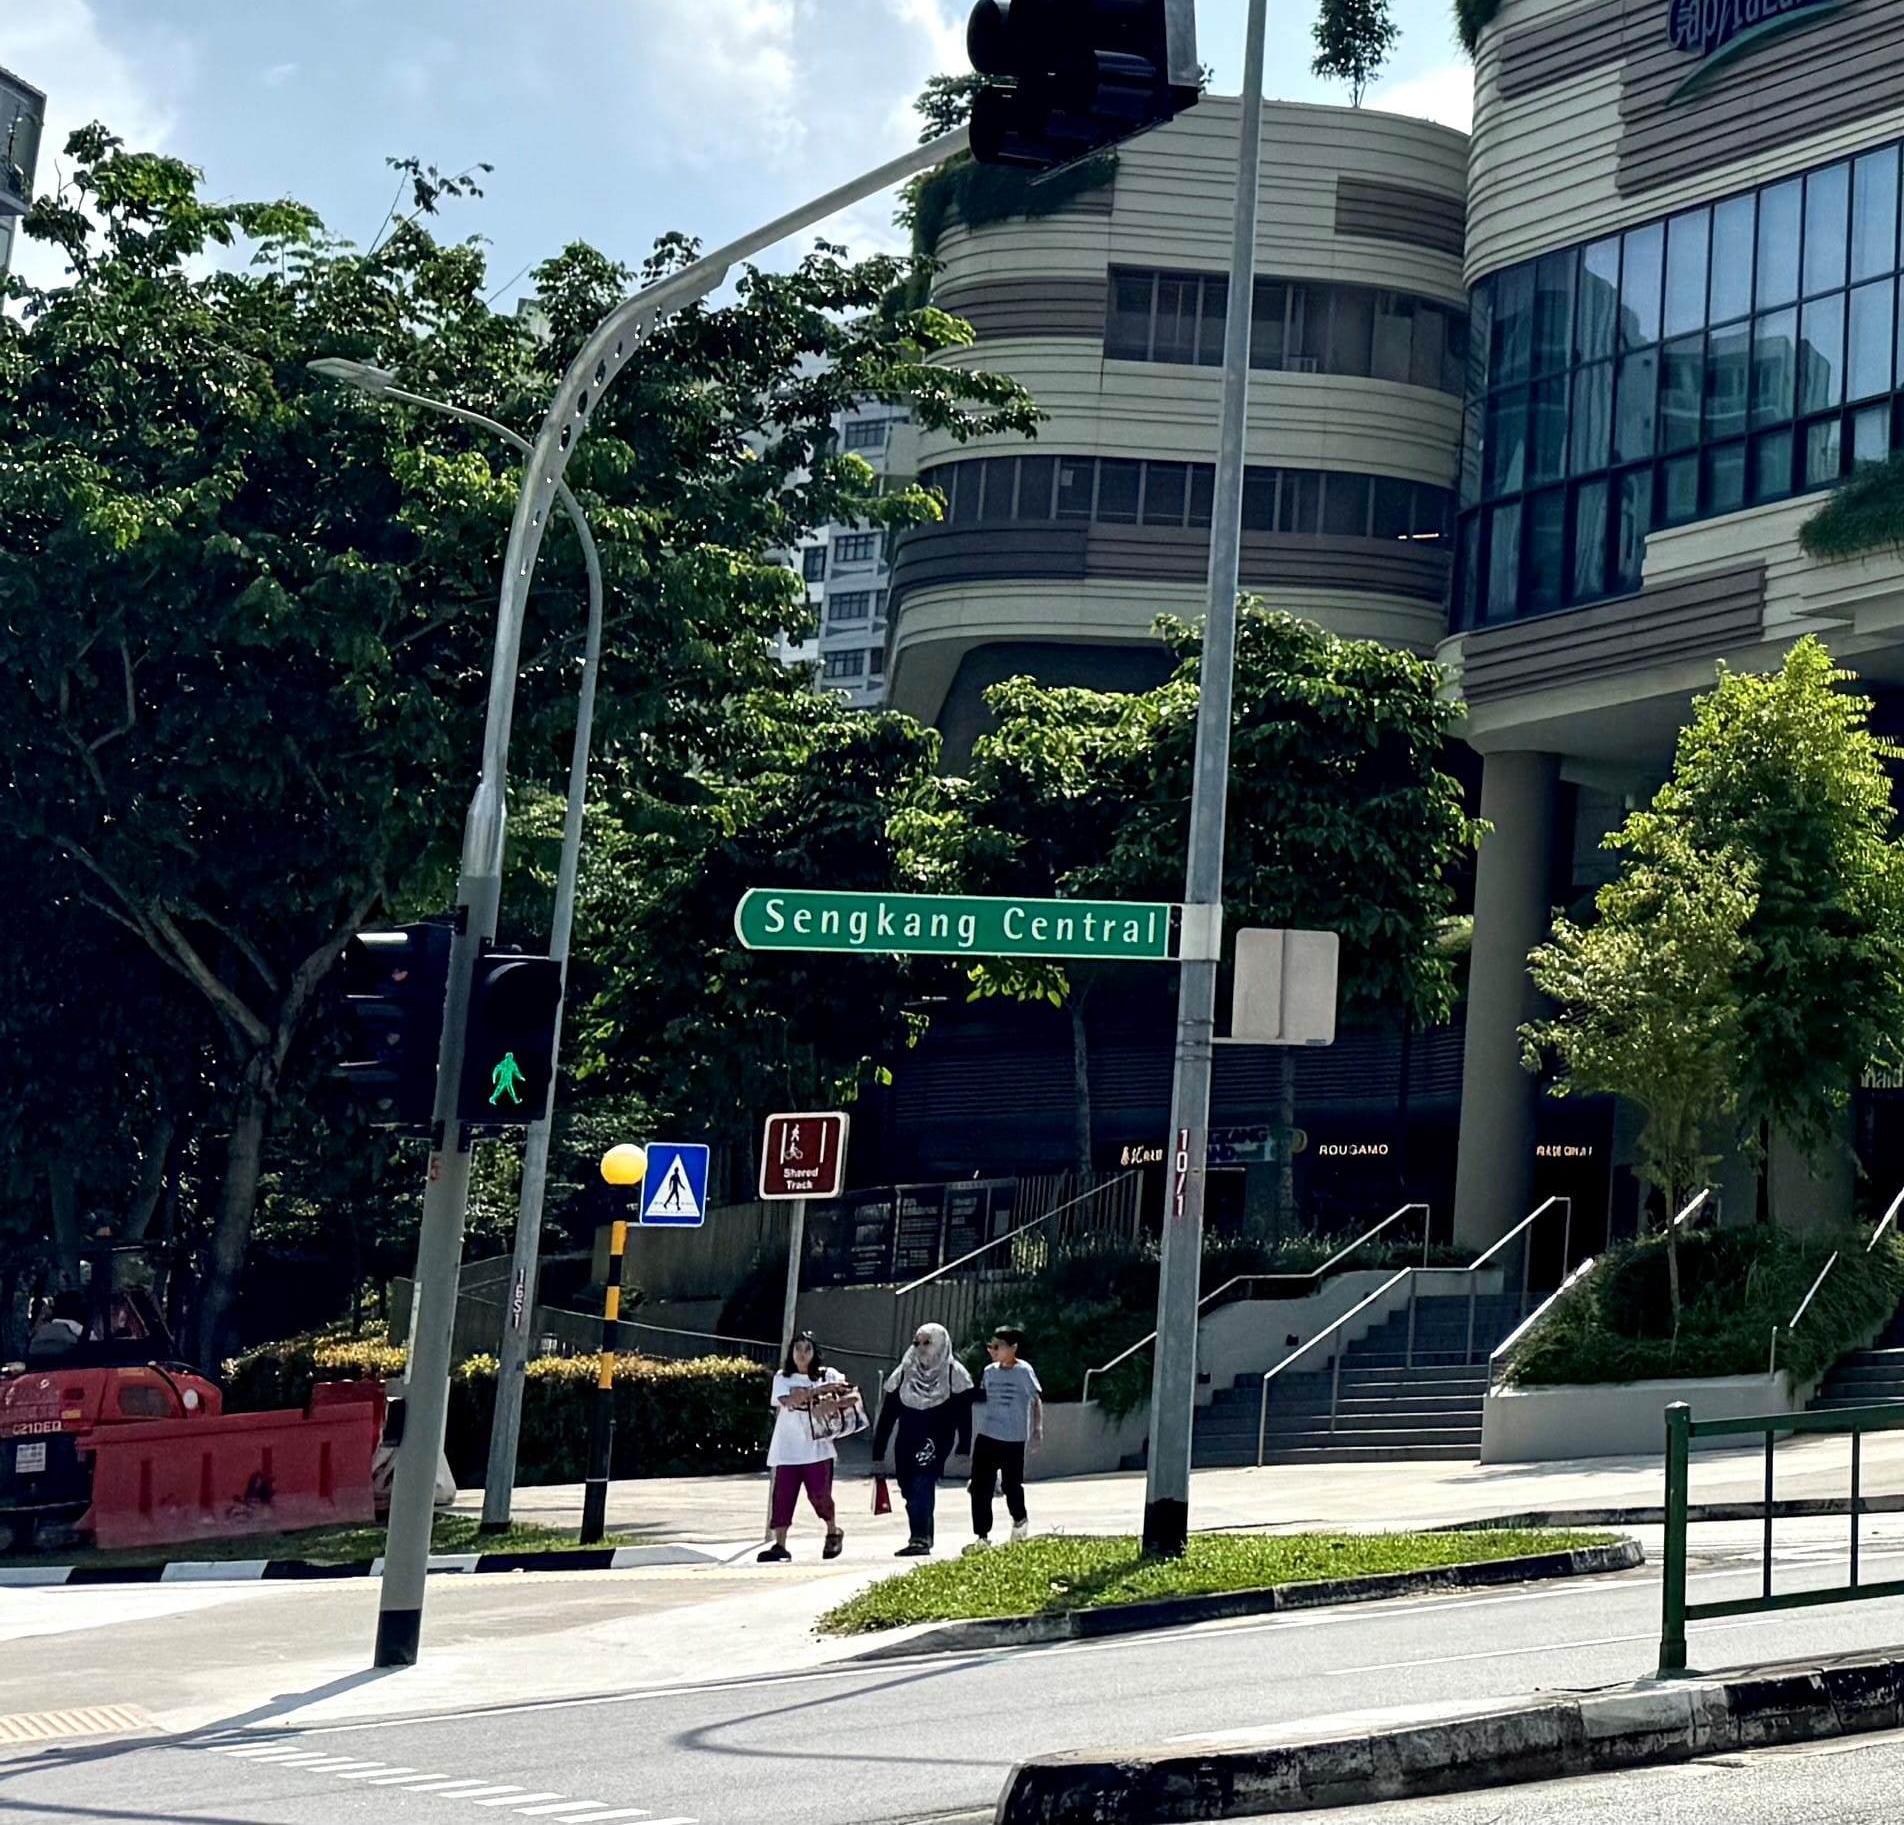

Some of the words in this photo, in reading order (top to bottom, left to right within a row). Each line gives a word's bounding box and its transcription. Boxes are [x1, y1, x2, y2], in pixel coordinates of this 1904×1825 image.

[765, 899, 976, 948] Sengkang
[1003, 906, 1156, 943] Central
[783, 1167, 819, 1178] Shared
[786, 1180, 813, 1190] Track
[1174, 1129, 1188, 1217] 10/1
